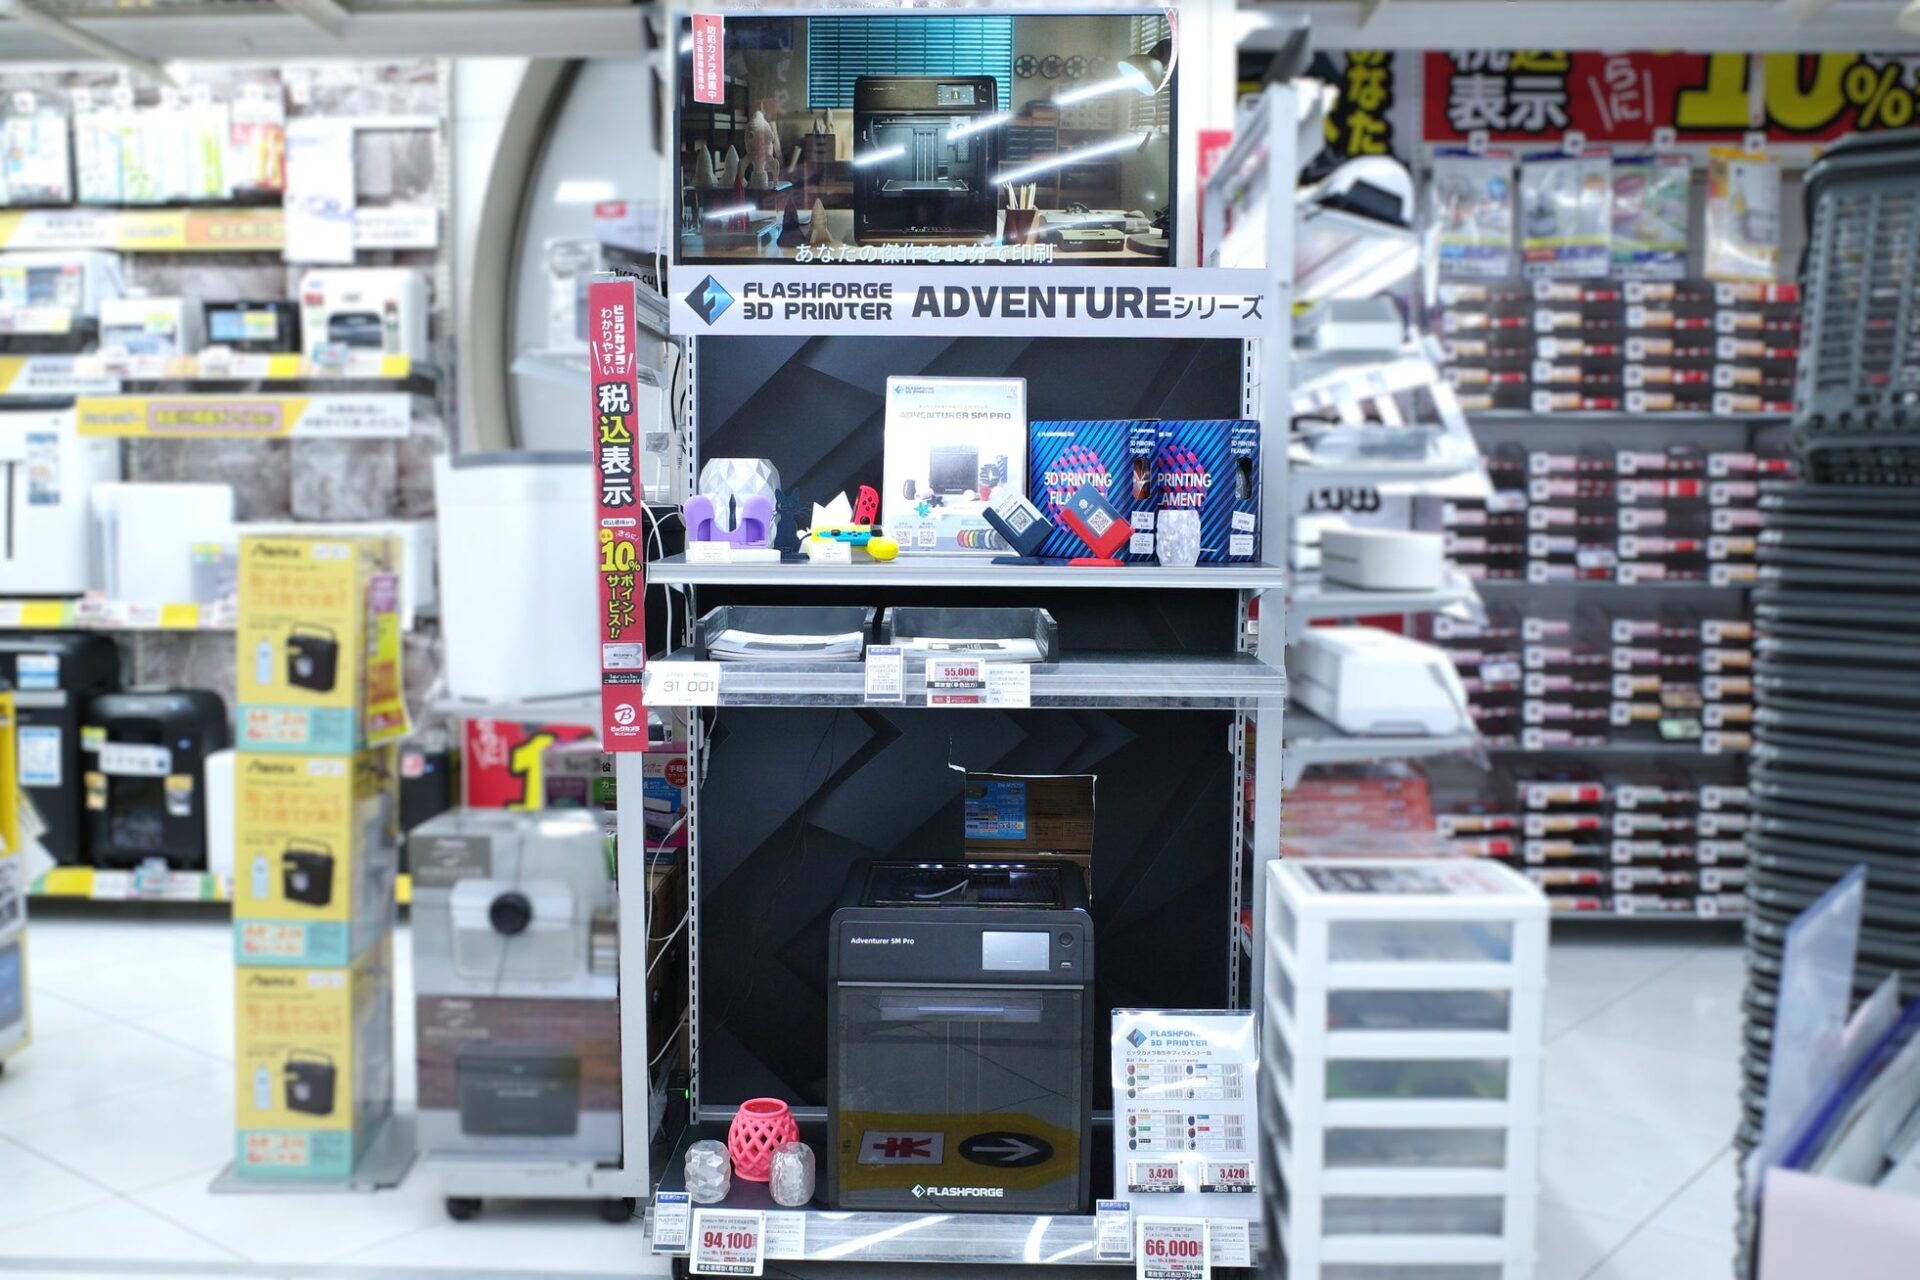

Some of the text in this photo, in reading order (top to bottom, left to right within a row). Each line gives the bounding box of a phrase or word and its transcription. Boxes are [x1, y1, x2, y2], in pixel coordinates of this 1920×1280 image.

[1448, 73, 1570, 130] 表示
[795, 243, 1055, 264] あなたの傑作を15分で印刷
[743, 282, 893, 299] FLASHFORGE
[743, 302, 893, 320] 3D PRINTER
[600, 307, 614, 376] わかりやすい
[990, 412, 1012, 420] PRO
[599, 384, 633, 506] 税込表示
[1043, 471, 1113, 487] 3D PRINTING
[1157, 472, 1213, 487] PRINTING
[601, 540, 641, 572] 10%
[620, 574, 636, 627] ポイント
[944, 667, 975, 677] 55,000
[850, 937, 889, 945] Adventurer
[1148, 1168, 1174, 1179] 3,420
[1220, 1168, 1245, 1179] 3,420
[927, 1187, 1004, 1197] FLASHFORGE
[703, 1231, 754, 1250] 94,100
[1145, 1239, 1199, 1257] 66,000
